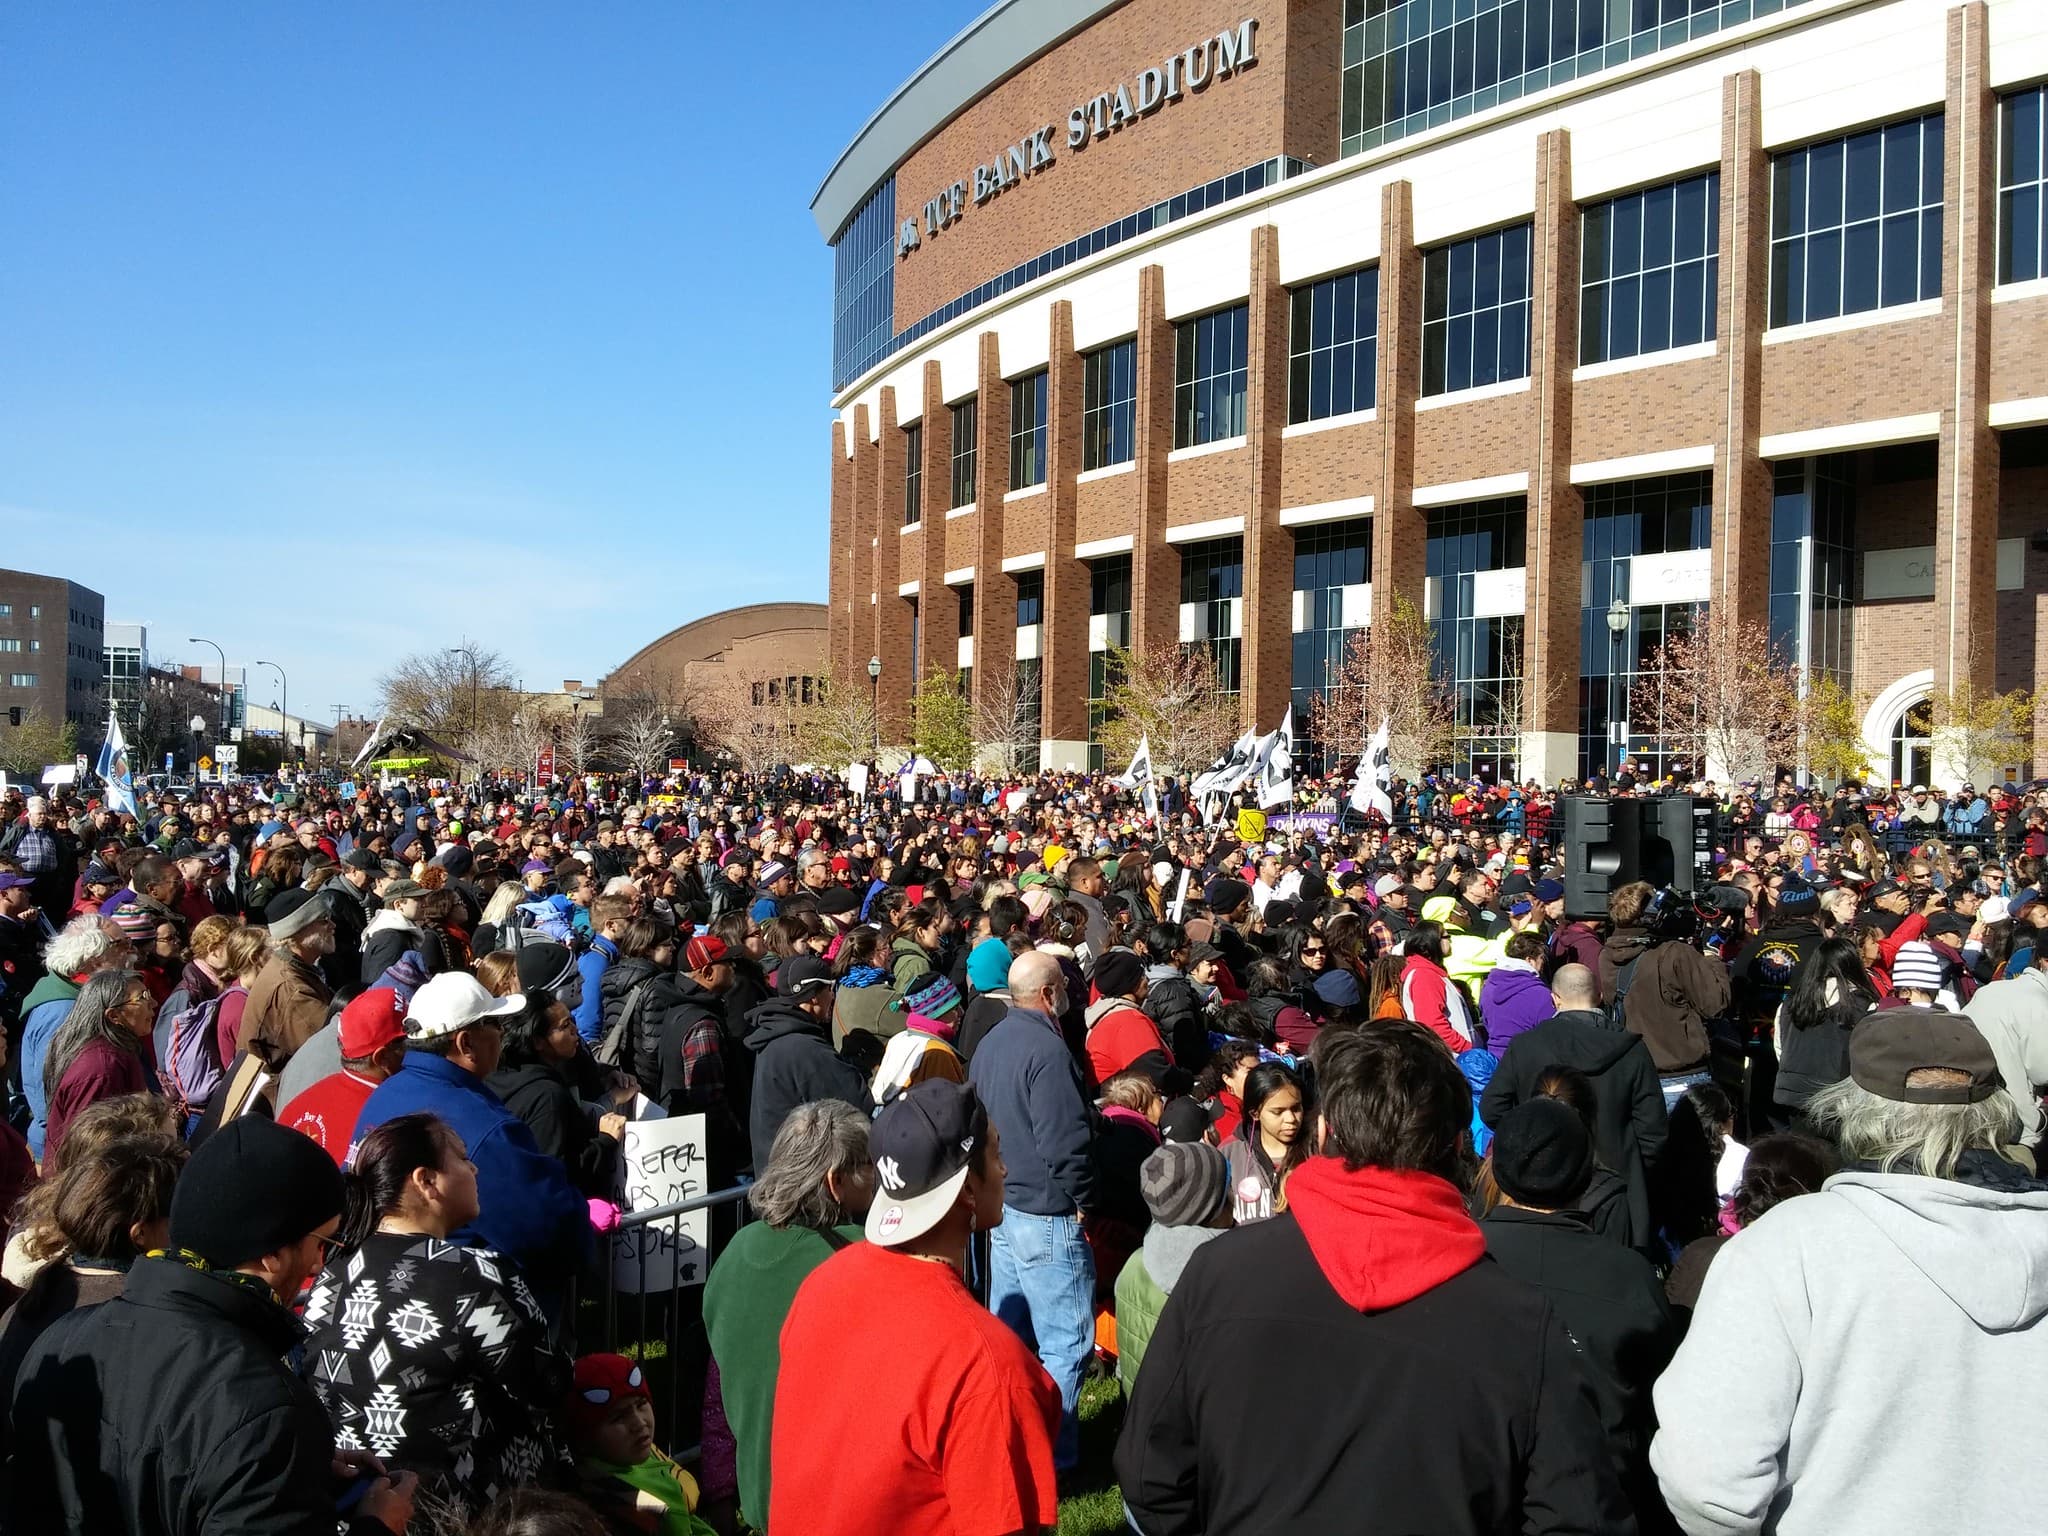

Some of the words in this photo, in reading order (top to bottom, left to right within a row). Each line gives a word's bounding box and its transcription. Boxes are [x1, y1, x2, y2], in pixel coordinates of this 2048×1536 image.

[924, 179, 967, 236] TCF
[973, 124, 1056, 204] BANK
[1067, 18, 1259, 150] STADIUM
